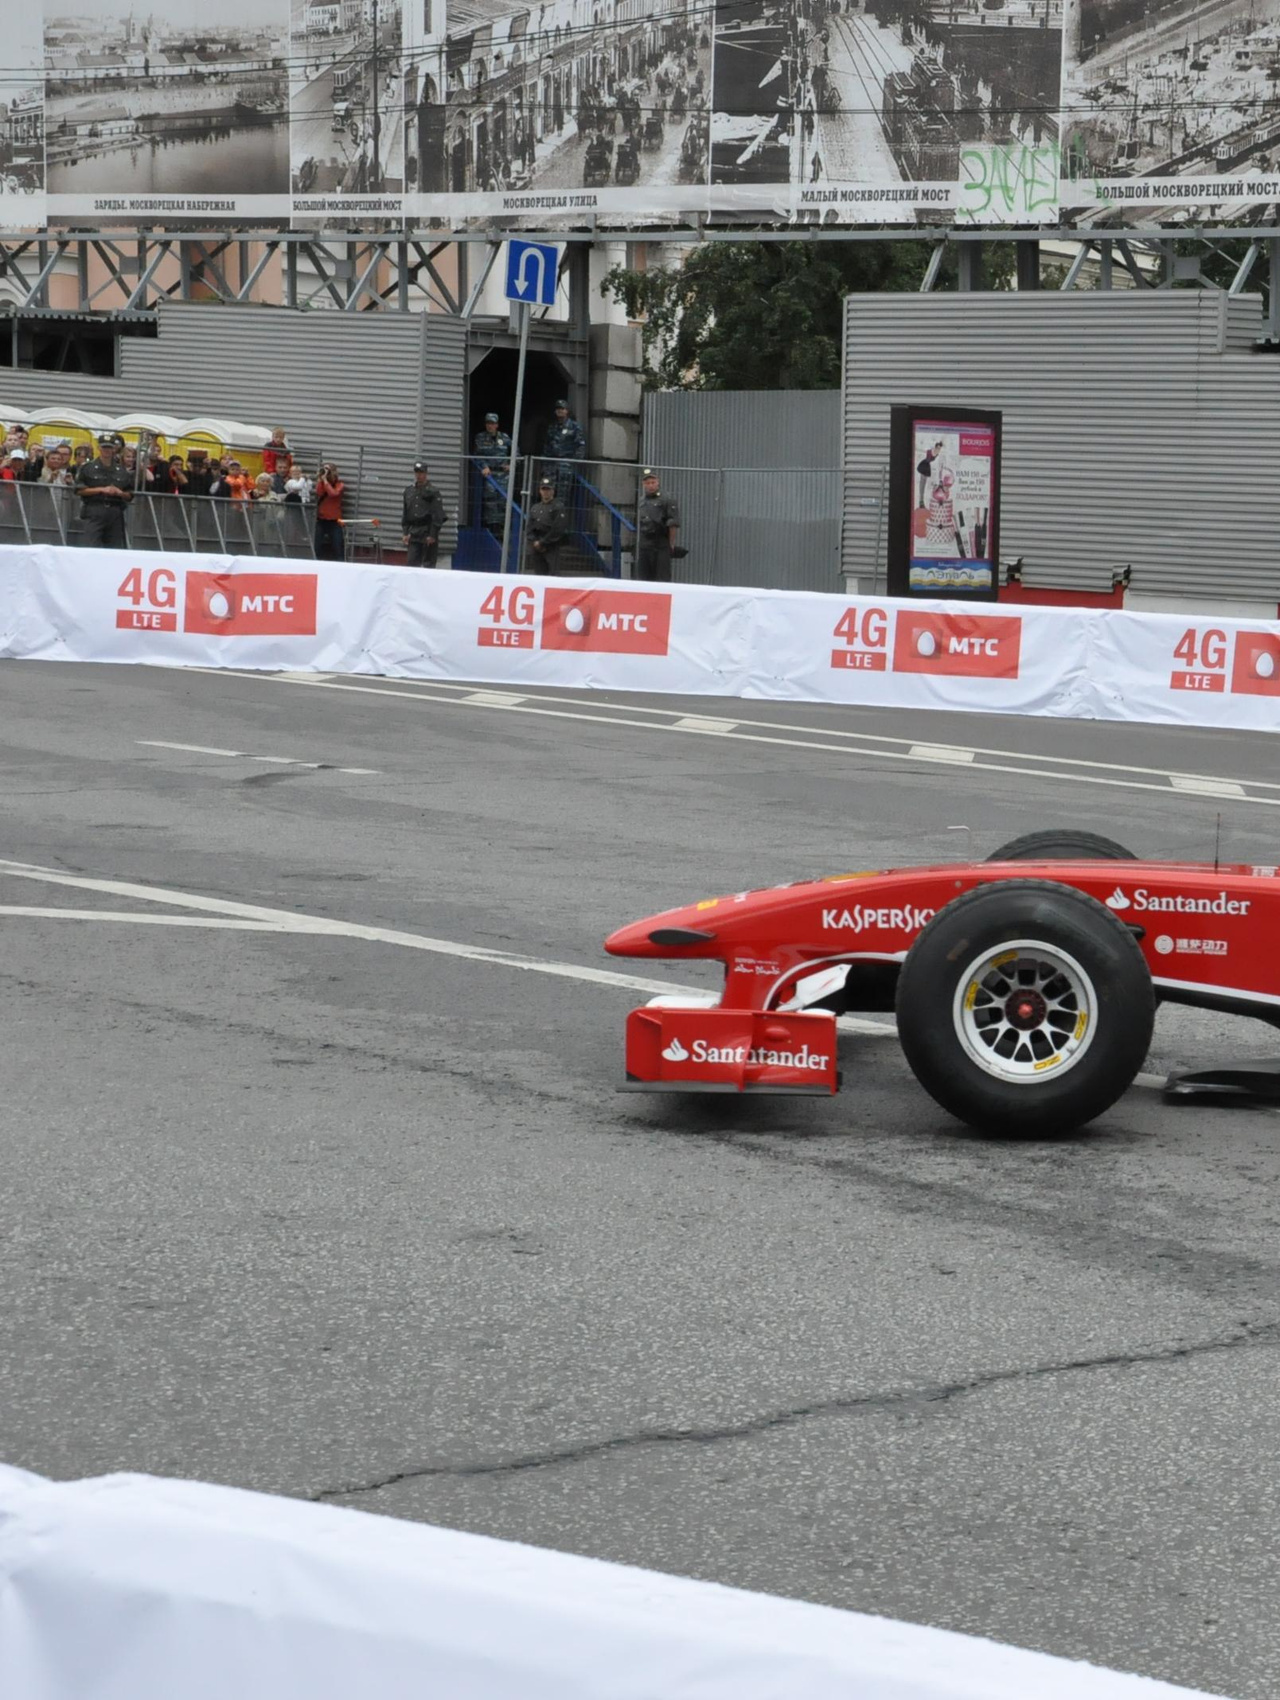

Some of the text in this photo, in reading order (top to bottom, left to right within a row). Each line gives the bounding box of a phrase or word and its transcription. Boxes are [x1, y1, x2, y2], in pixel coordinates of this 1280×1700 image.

[801, 186, 951, 203] МАЛЫЙ МОСКВОРЕЦКИЙ МОСТ
[1096, 182, 1150, 199] БОЛЬШОЙ
[1152, 179, 1244, 198] МОСКВОРЕЦКИЙ
[94, 200, 236, 211] ЗАРЯДЬЕ. МОСКВОРЕЦКАЯ НАБЕРЕЖНАЯ
[293, 198, 402, 212] БОЛЬШОЙ МОСКВОРЕЦКИЙ МОСТ
[503, 195, 598, 210] МОСКВОРЕЦКАЯ УЛИЦА
[117, 567, 176, 608] 4G
[241, 595, 294, 613] МТС
[479, 586, 535, 625] 4G
[132, 613, 161, 628] LTE
[597, 613, 648, 632] МТС
[833, 607, 887, 647] 4G
[493, 631, 519, 645] LTE
[948, 636, 998, 656] МТС
[1173, 628, 1226, 669] 4G
[846, 653, 872, 668] LTE
[1184, 675, 1211, 689] LTE
[1134, 888, 1251, 915] Santander
[691, 1039, 829, 1070] Santander
